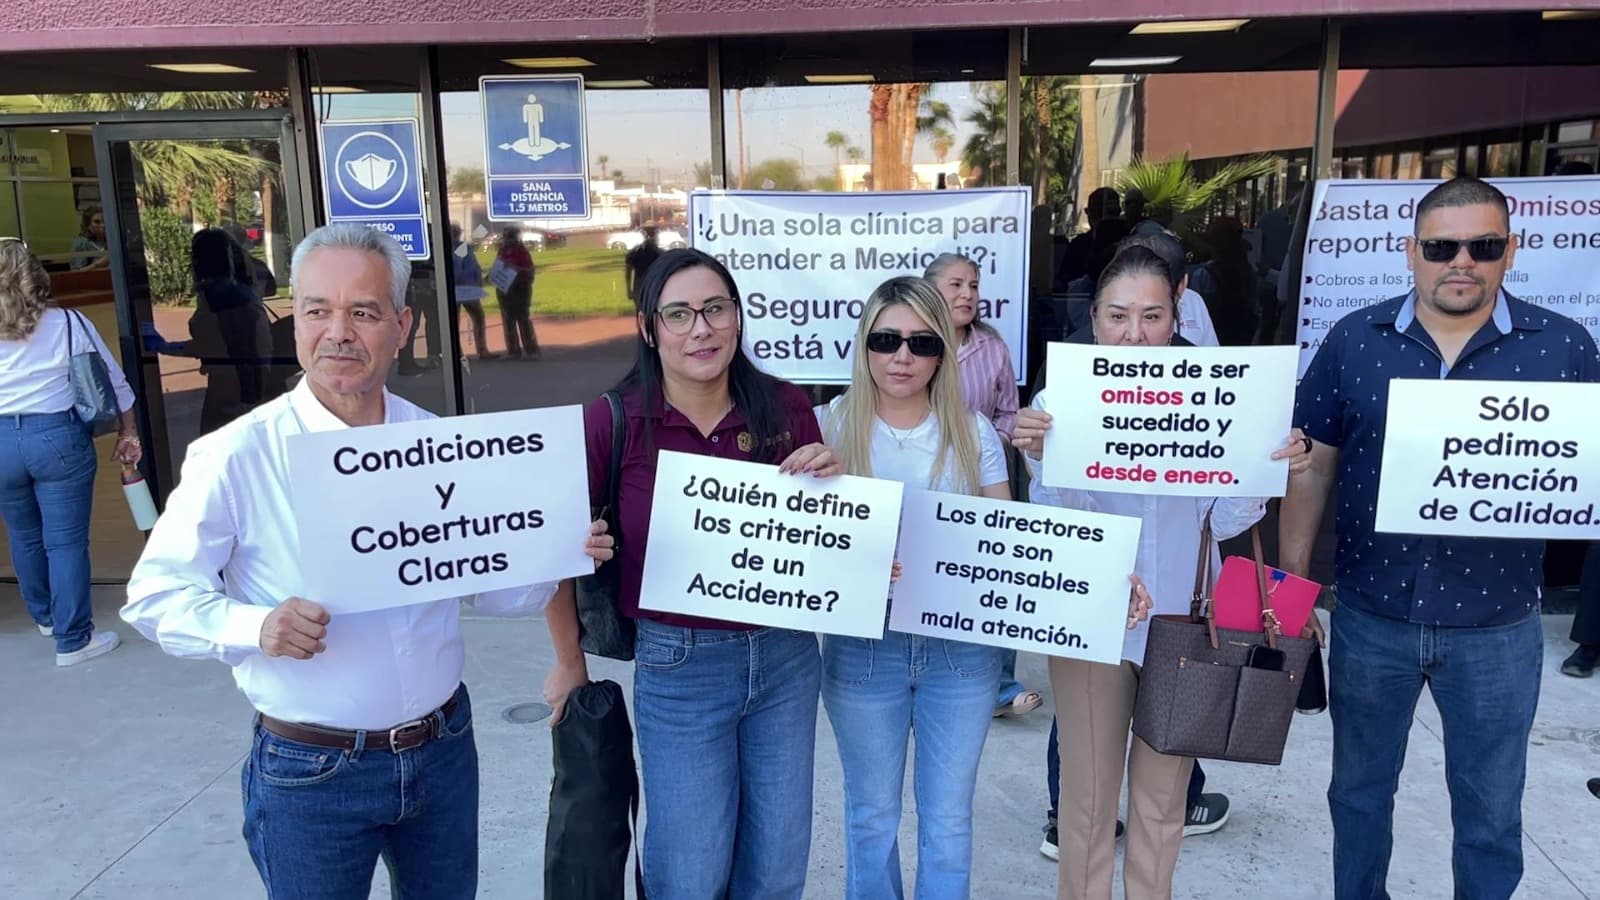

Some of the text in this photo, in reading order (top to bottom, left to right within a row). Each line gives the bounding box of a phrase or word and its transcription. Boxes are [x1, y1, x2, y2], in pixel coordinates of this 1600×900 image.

[511, 192, 565, 202] DISTANCIA
[523, 182, 552, 192] SANA
[509, 203, 568, 213] 1.5 METROS
[783, 212, 841, 236] sola
[850, 212, 943, 236] clínica
[952, 215, 1019, 240] para
[1308, 231, 1408, 259] reporta
[830, 252, 846, 270] a
[1315, 273, 1365, 286] Cobros
[1369, 276, 1378, 285] a
[1383, 273, 1403, 285] los
[746, 292, 866, 326] Seguro
[1313, 297, 1333, 308] No
[1547, 293, 1565, 304] en
[1569, 291, 1581, 304] el
[753, 333, 823, 360] está
[1093, 357, 1250, 378] Basta de ser
[1101, 385, 1236, 406] omisos a lo
[1479, 396, 1550, 422] Sólo
[1102, 413, 1232, 437] sucedido y
[333, 433, 544, 475] Condiciones
[1105, 440, 1225, 461] reportado
[1442, 432, 1578, 461] pedimos
[1086, 461, 1240, 485] desde enero.
[1432, 464, 1578, 493] Atención
[435, 482, 455, 510] y
[683, 475, 871, 520] ¿Quién define
[936, 502, 1104, 543] Los directores
[1419, 498, 1600, 526] de Calidad.
[351, 509, 544, 554] Coberturas
[694, 508, 851, 550] los criterios
[731, 548, 805, 577] de un
[977, 539, 1053, 563] no son
[398, 552, 509, 586] Claras
[935, 560, 1090, 595] responsables
[687, 573, 840, 613] Accidente?
[979, 590, 1036, 614] de la
[921, 612, 1088, 649] mala atención.
